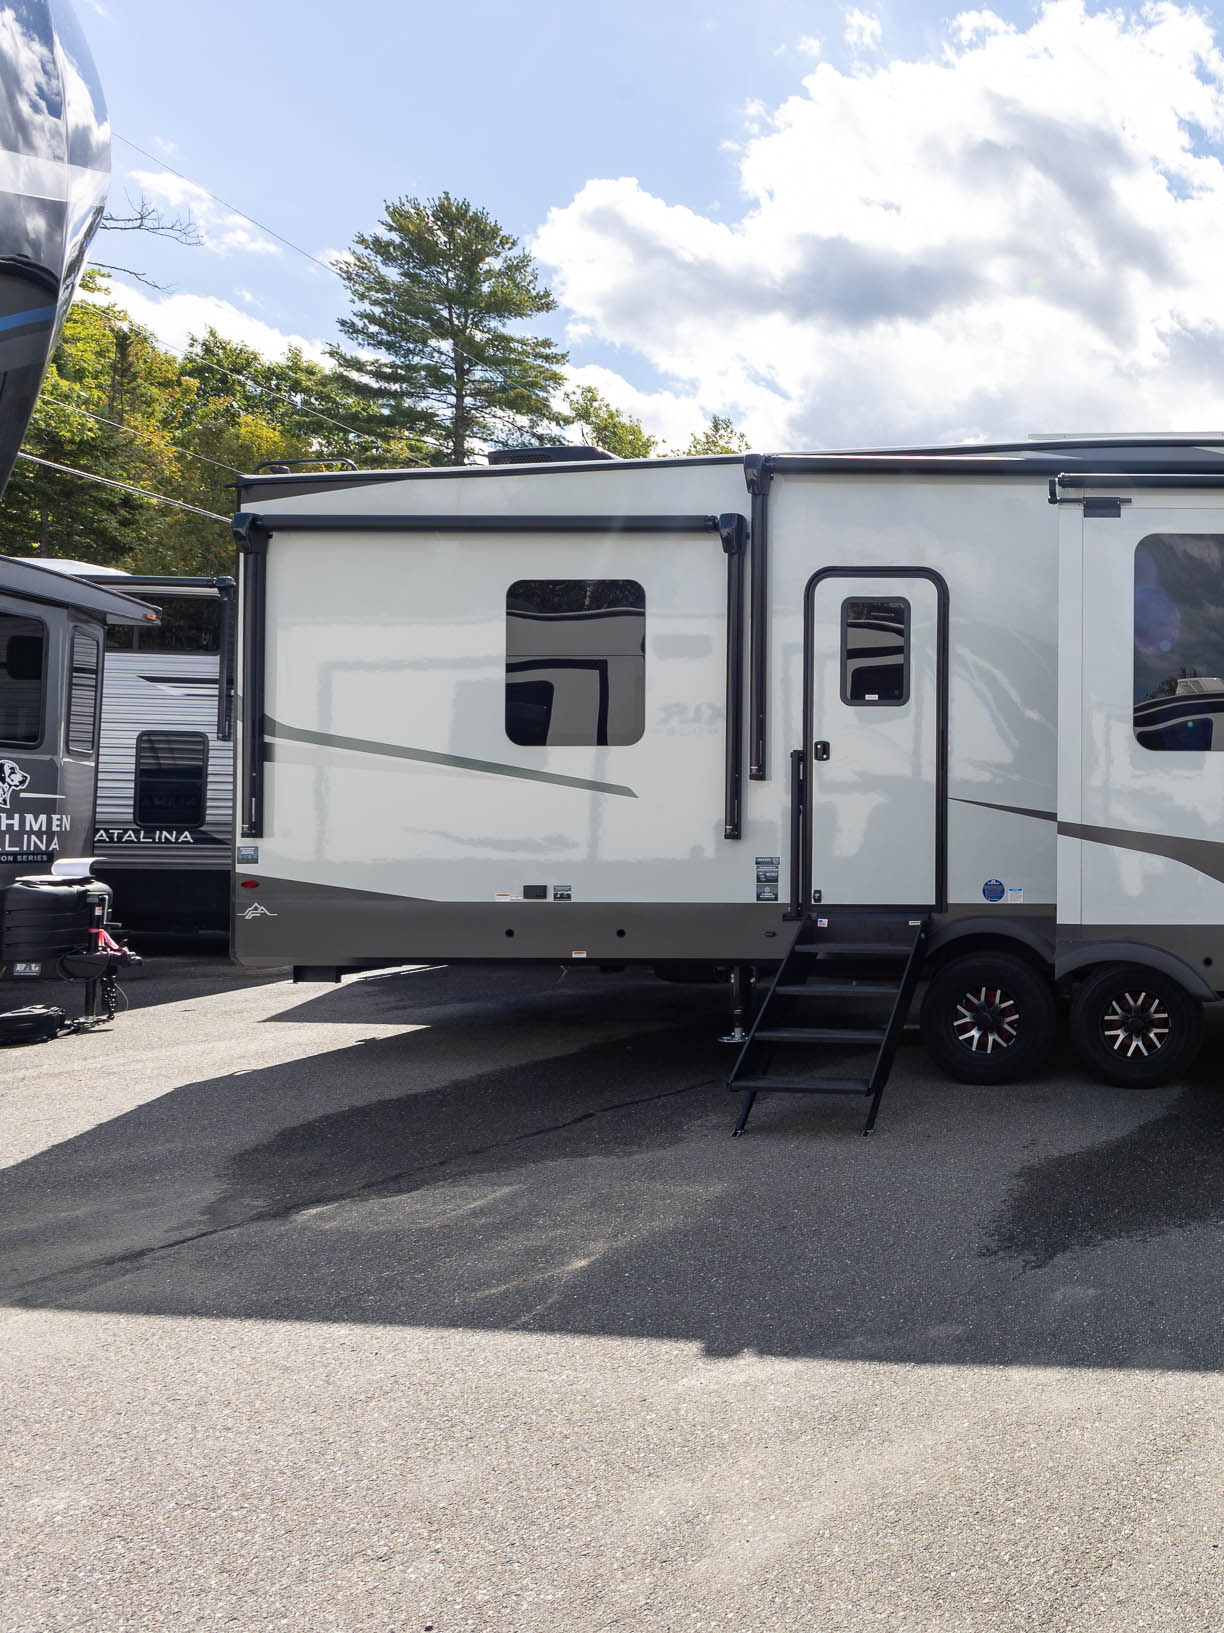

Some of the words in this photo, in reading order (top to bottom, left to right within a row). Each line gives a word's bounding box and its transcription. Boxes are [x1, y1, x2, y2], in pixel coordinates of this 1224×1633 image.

[0, 813, 71, 831] HMEN
[0, 834, 60, 851] LINA
[94, 830, 194, 843] ATALINA
[17, 854, 48, 862] SERIES
